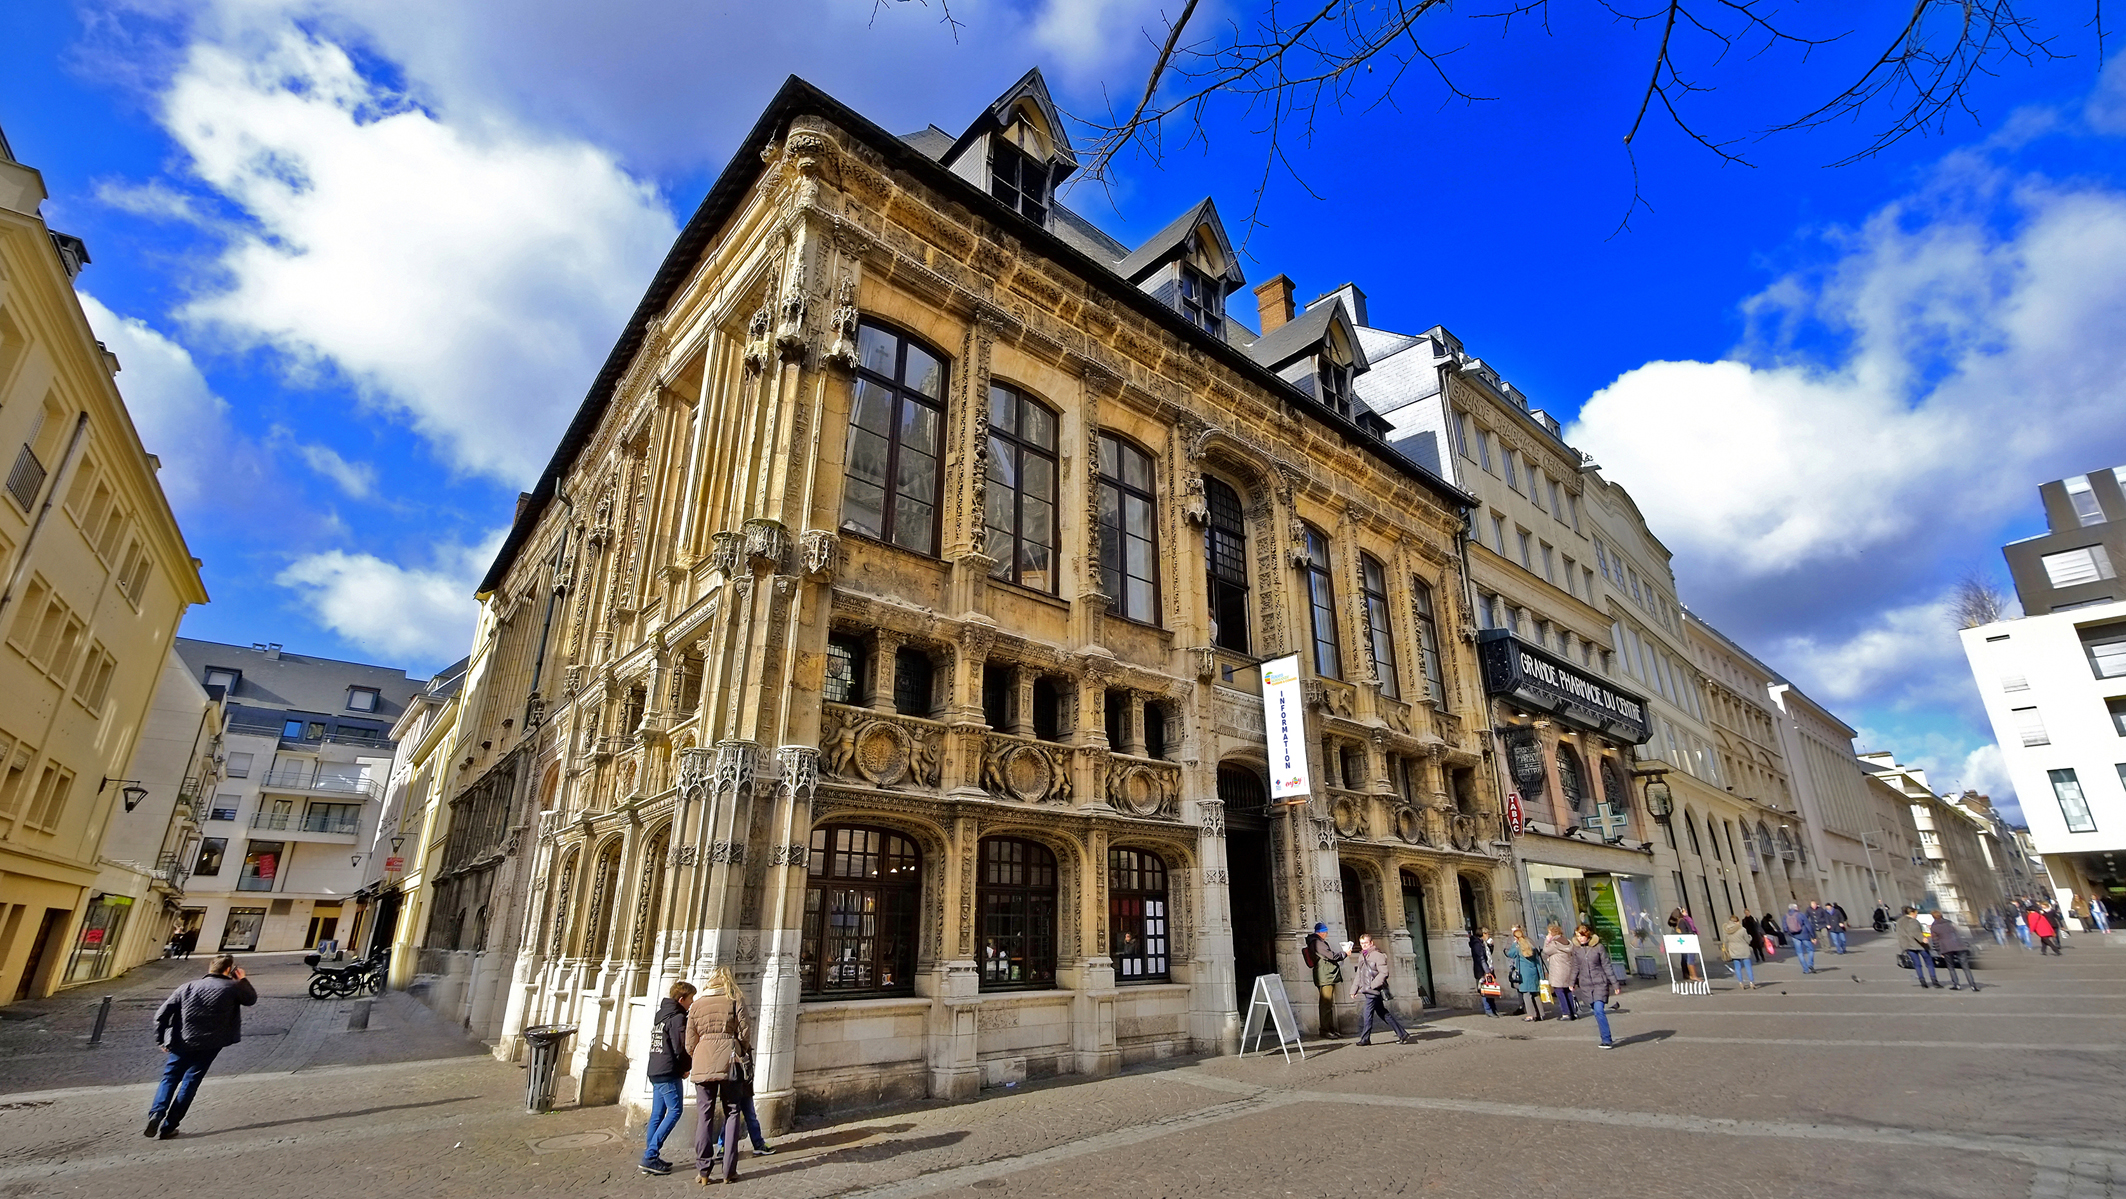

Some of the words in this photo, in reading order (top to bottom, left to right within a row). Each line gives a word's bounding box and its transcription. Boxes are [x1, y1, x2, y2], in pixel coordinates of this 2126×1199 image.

[1520, 652, 1559, 687] GRANDE
[1558, 669, 1604, 707] PHARMACIE
[1602, 689, 1616, 711] DU
[1615, 696, 1643, 723] CENTRE
[1279, 690, 1291, 769] INFORMATION
[1509, 796, 1520, 832] TABAC
